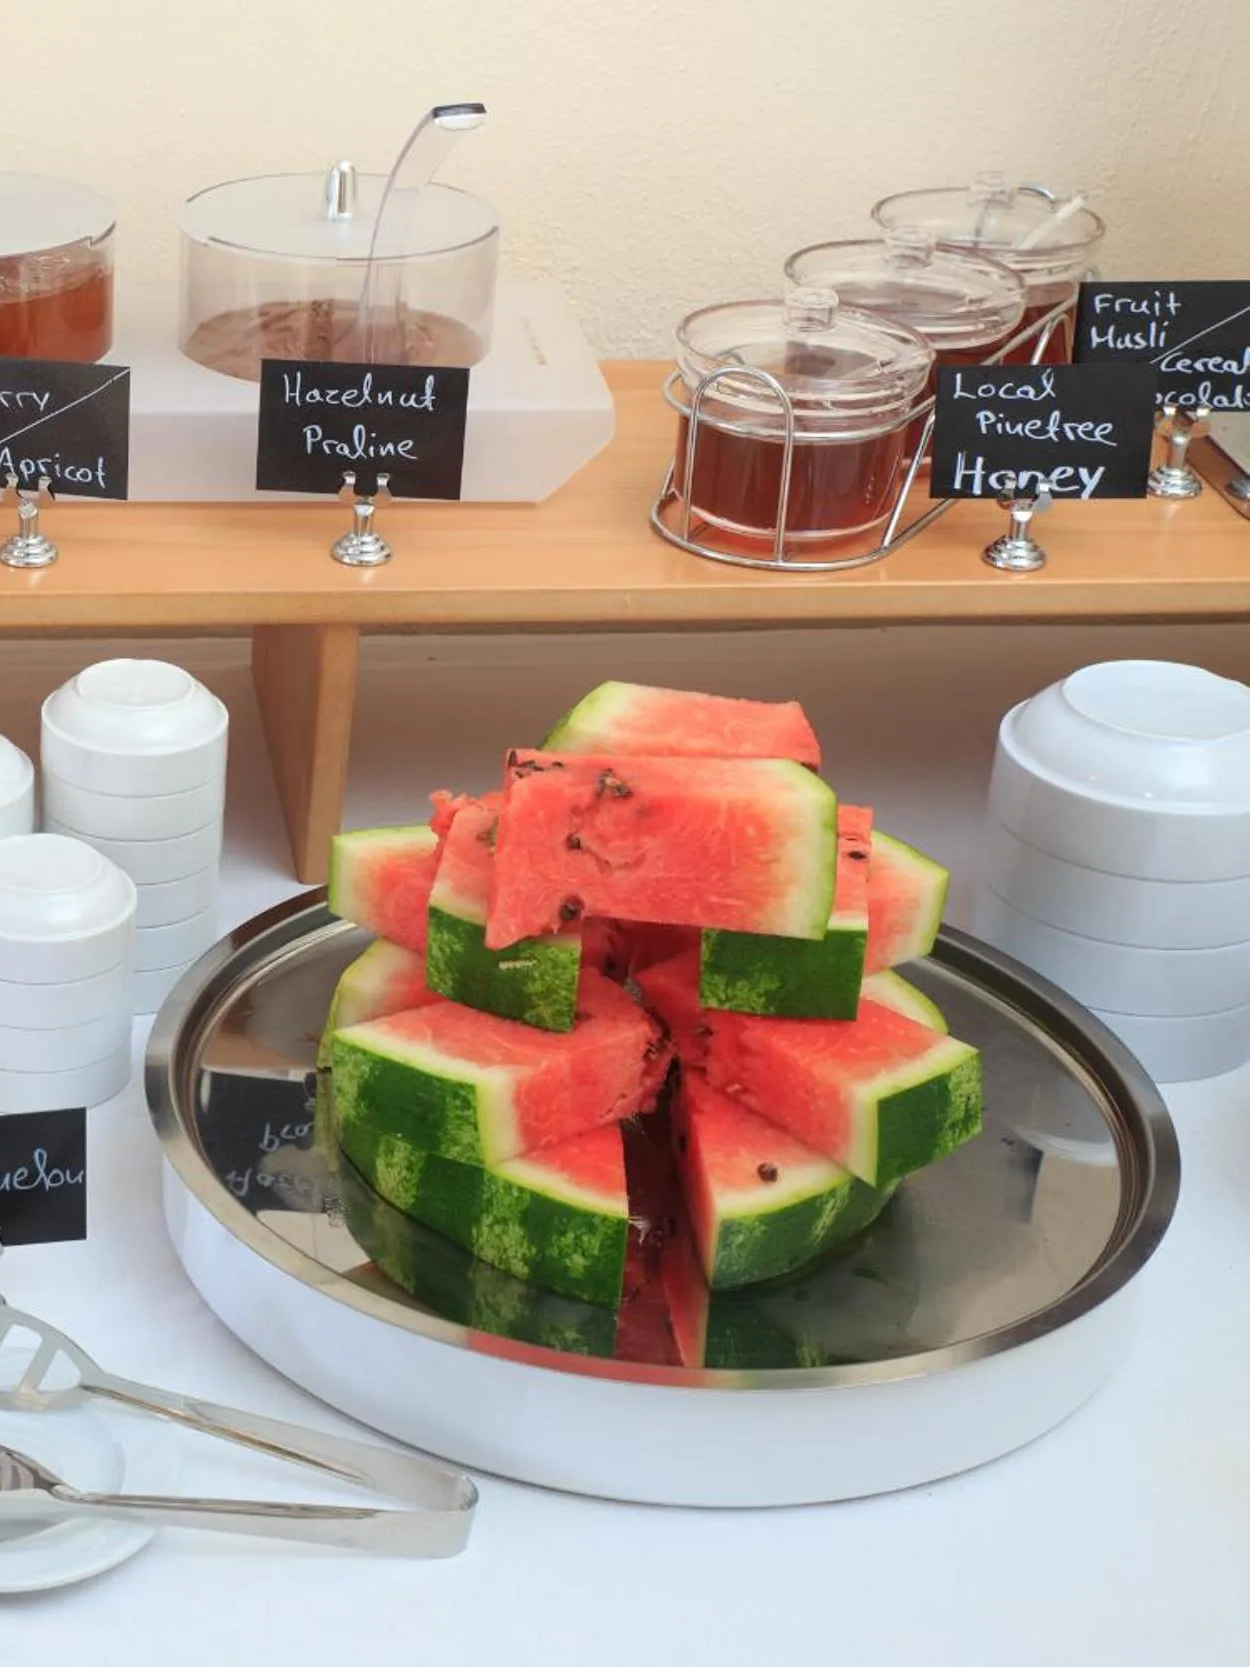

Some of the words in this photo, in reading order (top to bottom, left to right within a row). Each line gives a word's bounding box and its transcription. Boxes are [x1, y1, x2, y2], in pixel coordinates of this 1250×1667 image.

[1094, 290, 1182, 316] Fruit
[282, 371, 437, 411] Hazelnut
[953, 367, 1057, 401] Local
[302, 424, 419, 460] Praline
[953, 450, 1106, 501] Honey
